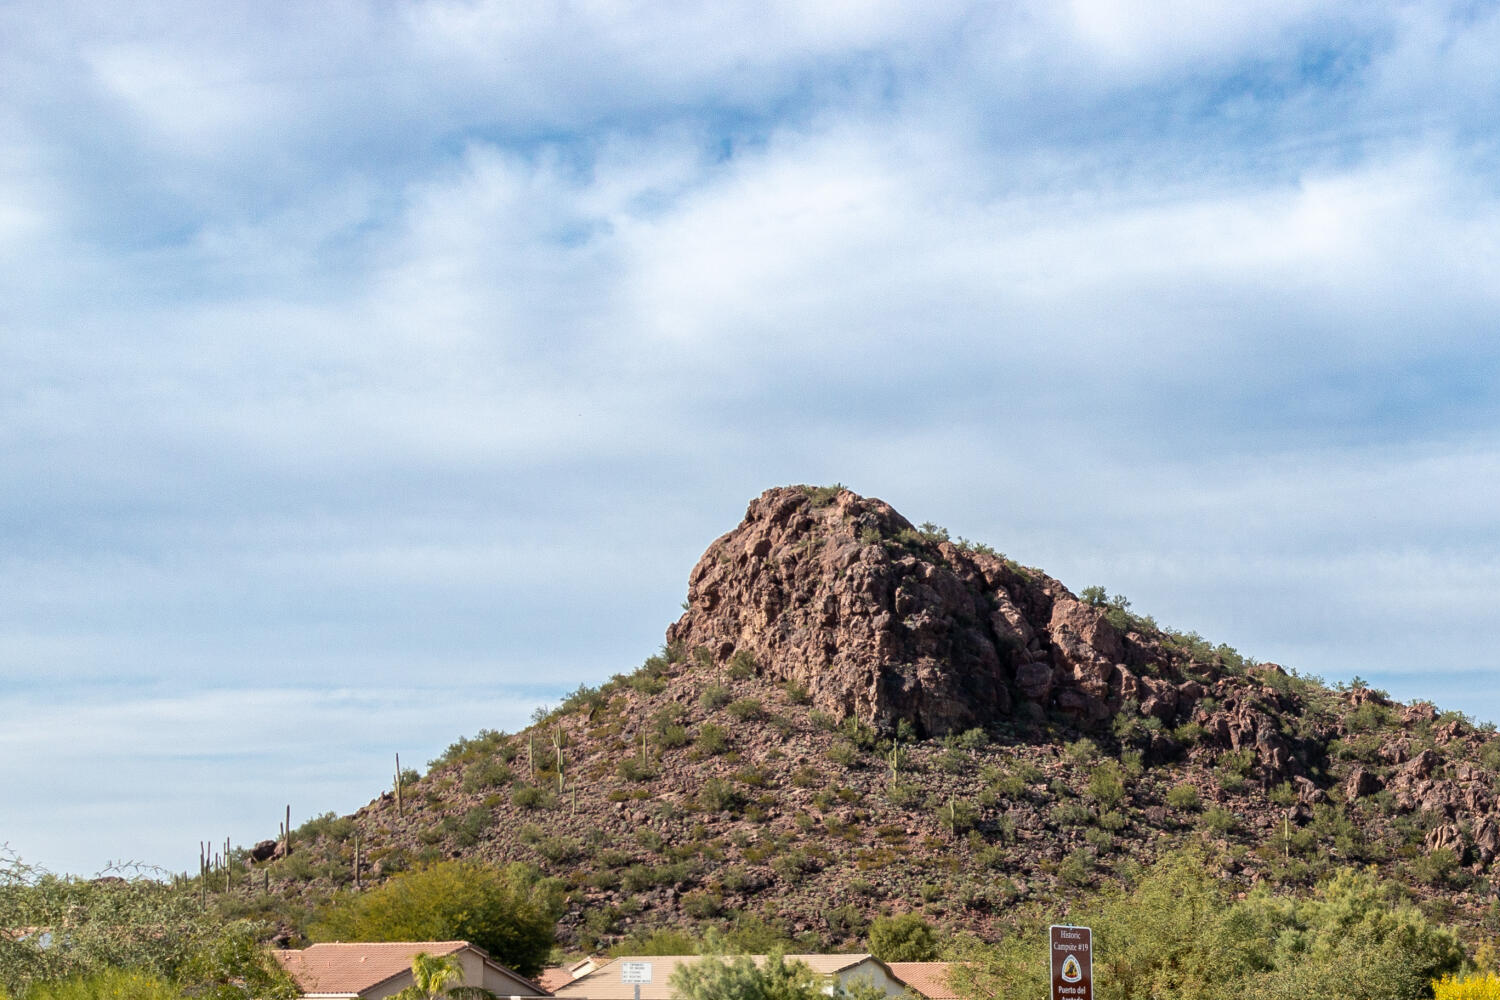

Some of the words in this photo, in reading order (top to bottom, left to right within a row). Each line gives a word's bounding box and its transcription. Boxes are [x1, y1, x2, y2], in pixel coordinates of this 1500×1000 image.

[1060, 930, 1081, 939] Historic
[1053, 942, 1077, 952] Campsite
[1078, 944, 1089, 952] #19
[1058, 986, 1076, 994] Puerto
[1077, 986, 1086, 994] del
